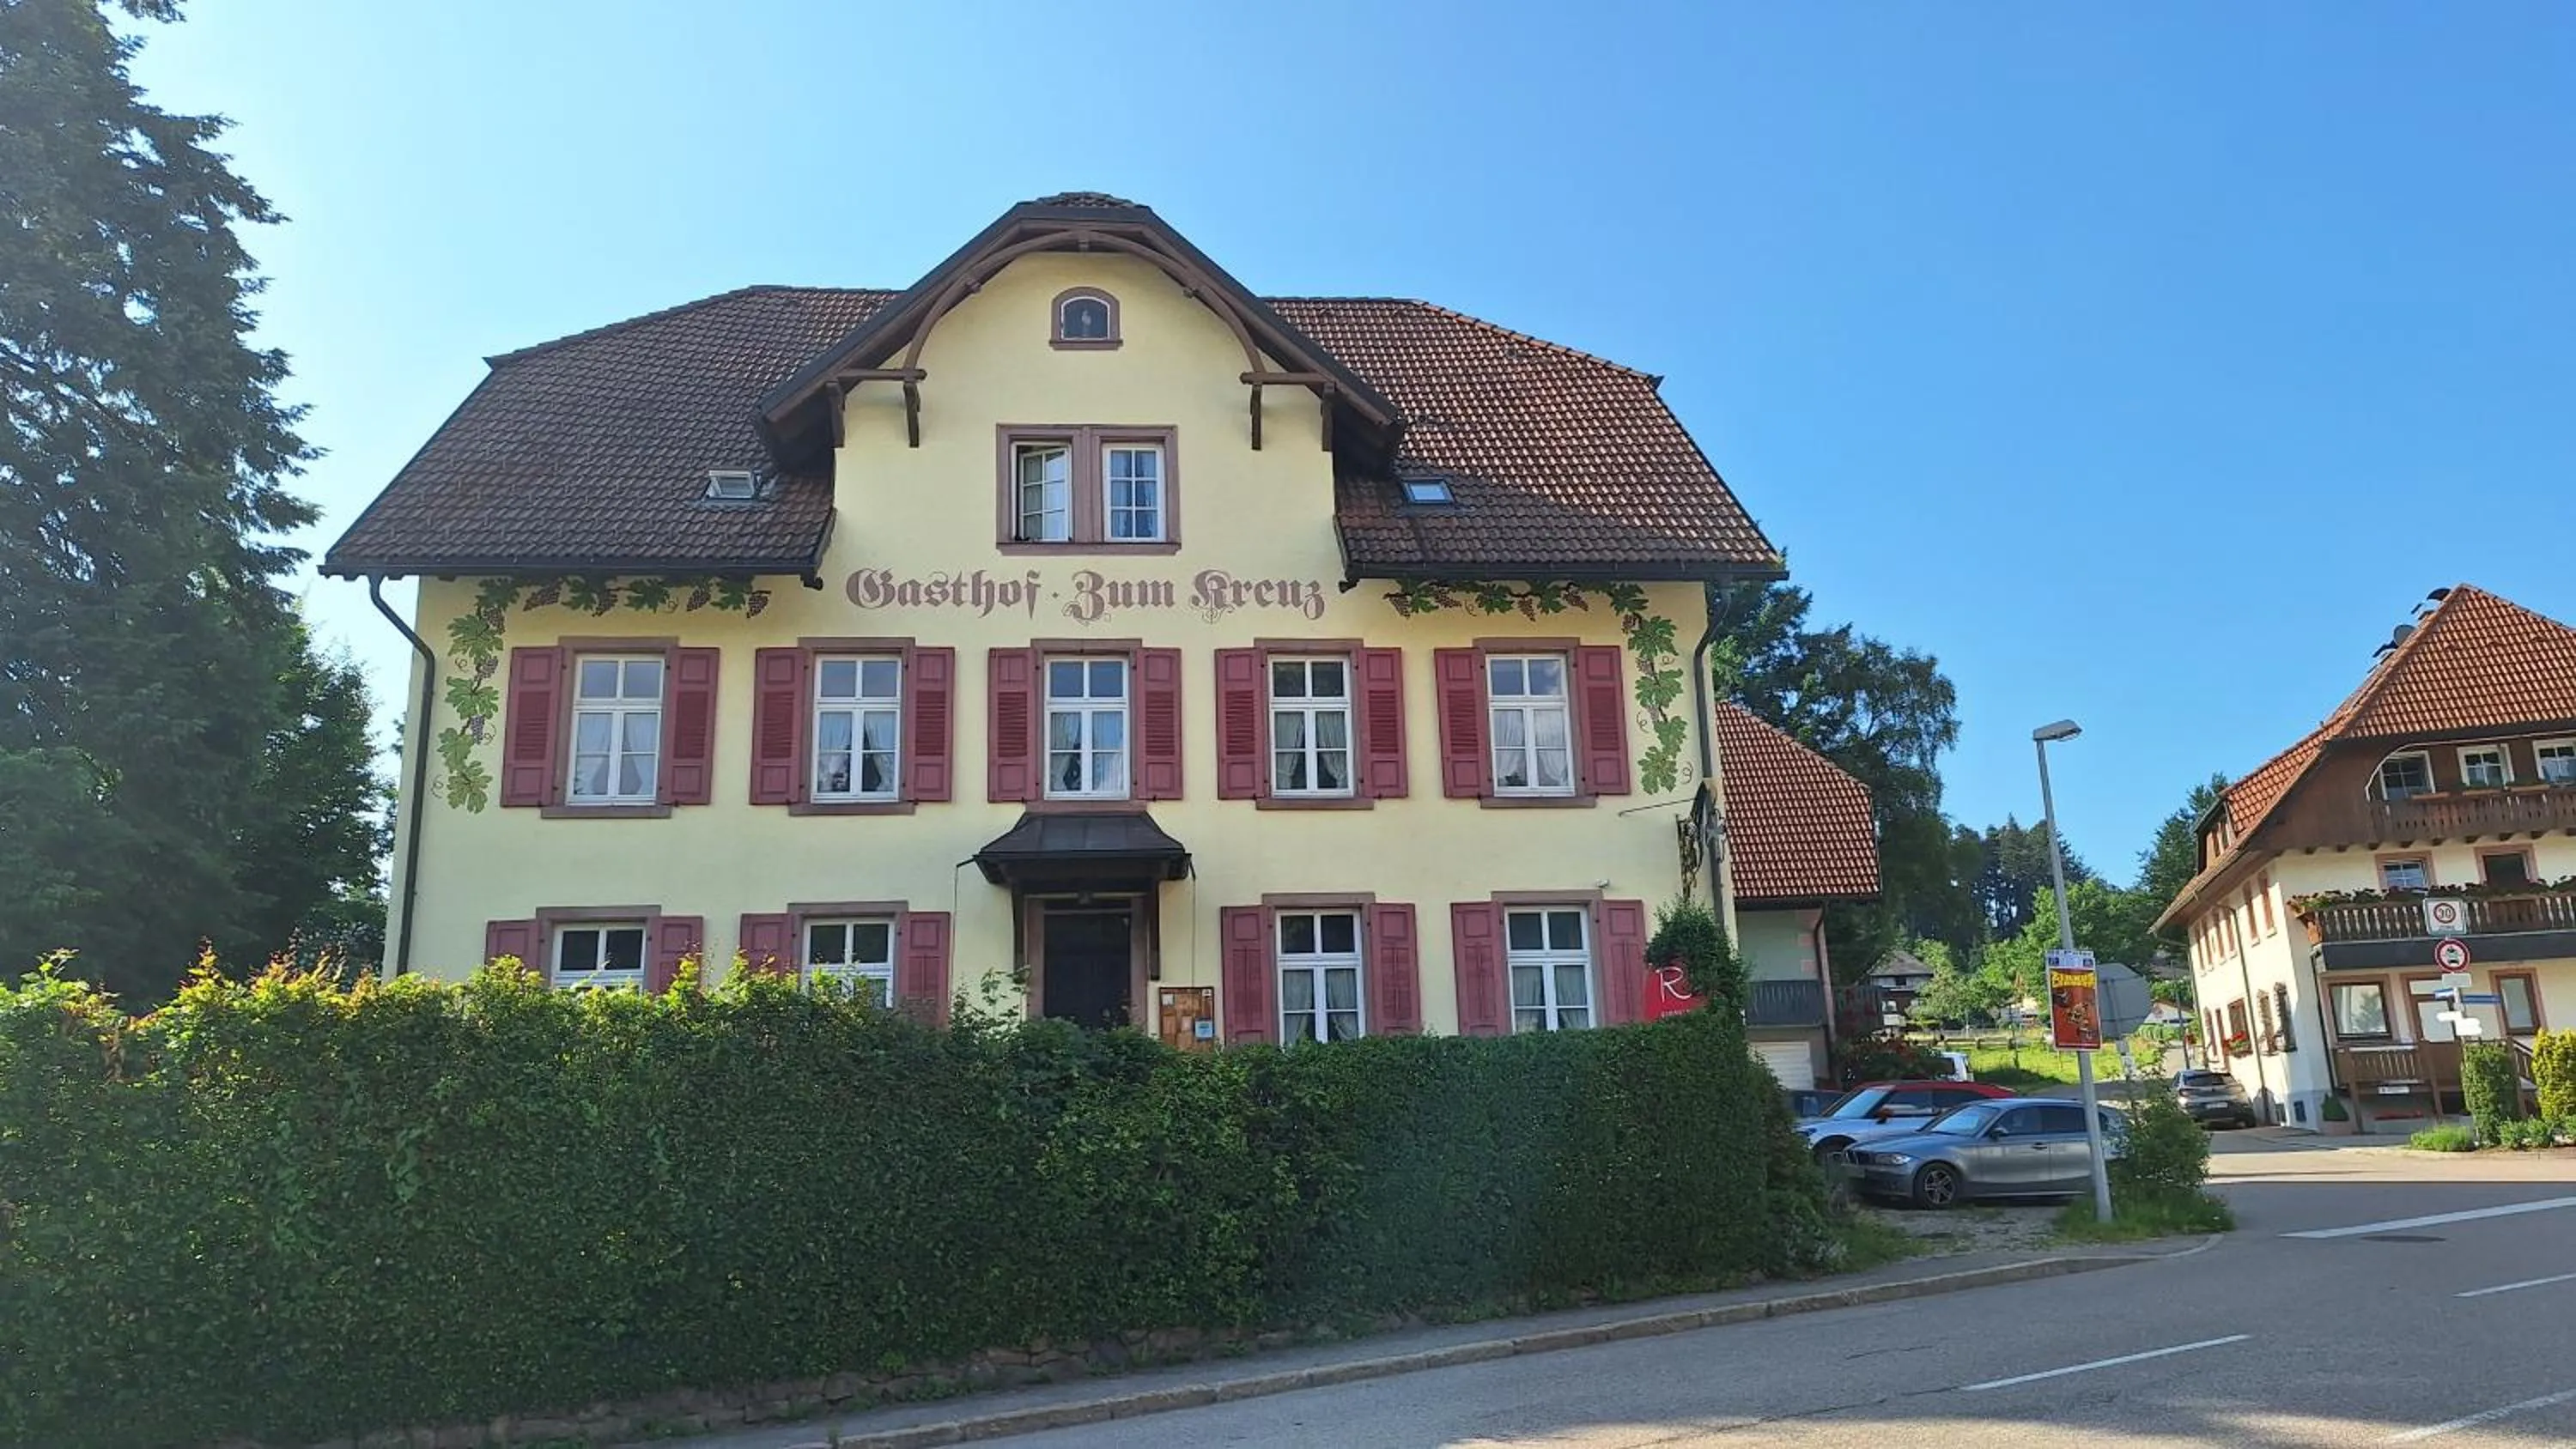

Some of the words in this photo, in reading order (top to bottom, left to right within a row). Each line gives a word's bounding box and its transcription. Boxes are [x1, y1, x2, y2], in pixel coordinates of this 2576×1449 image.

[846, 567, 1042, 619] Gasthof
[1061, 569, 1176, 625] Zum
[2438, 907, 2451, 919] 30
